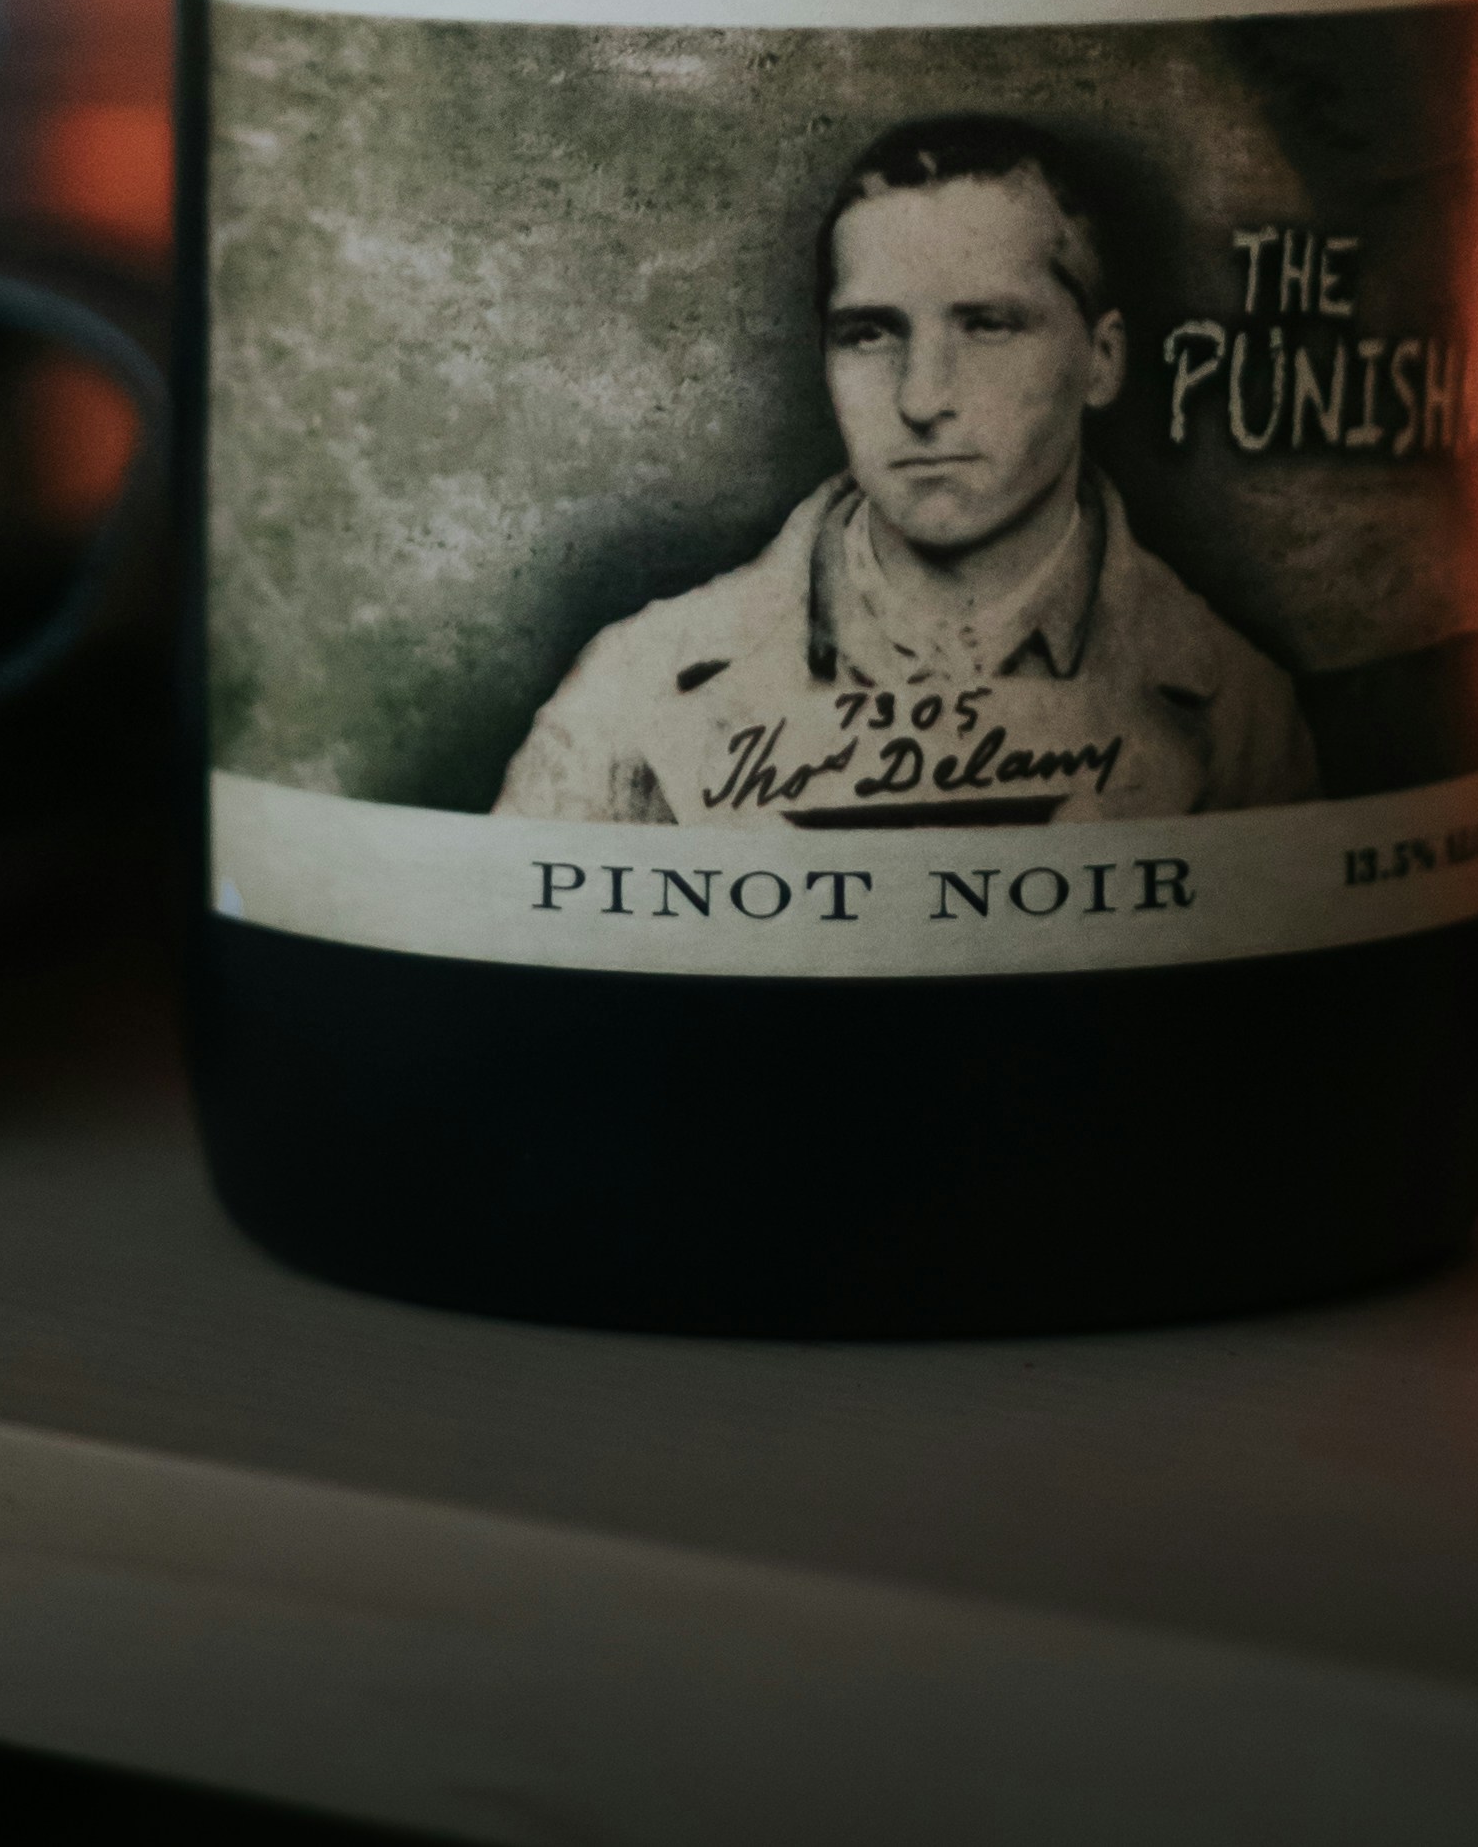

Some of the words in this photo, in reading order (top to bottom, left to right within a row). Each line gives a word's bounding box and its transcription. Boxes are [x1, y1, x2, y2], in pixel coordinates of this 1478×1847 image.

[1232, 225, 1360, 317] THE
[834, 686, 994, 740] 7305
[530, 860, 875, 922] PINOT
[928, 857, 1197, 922] NOIR
